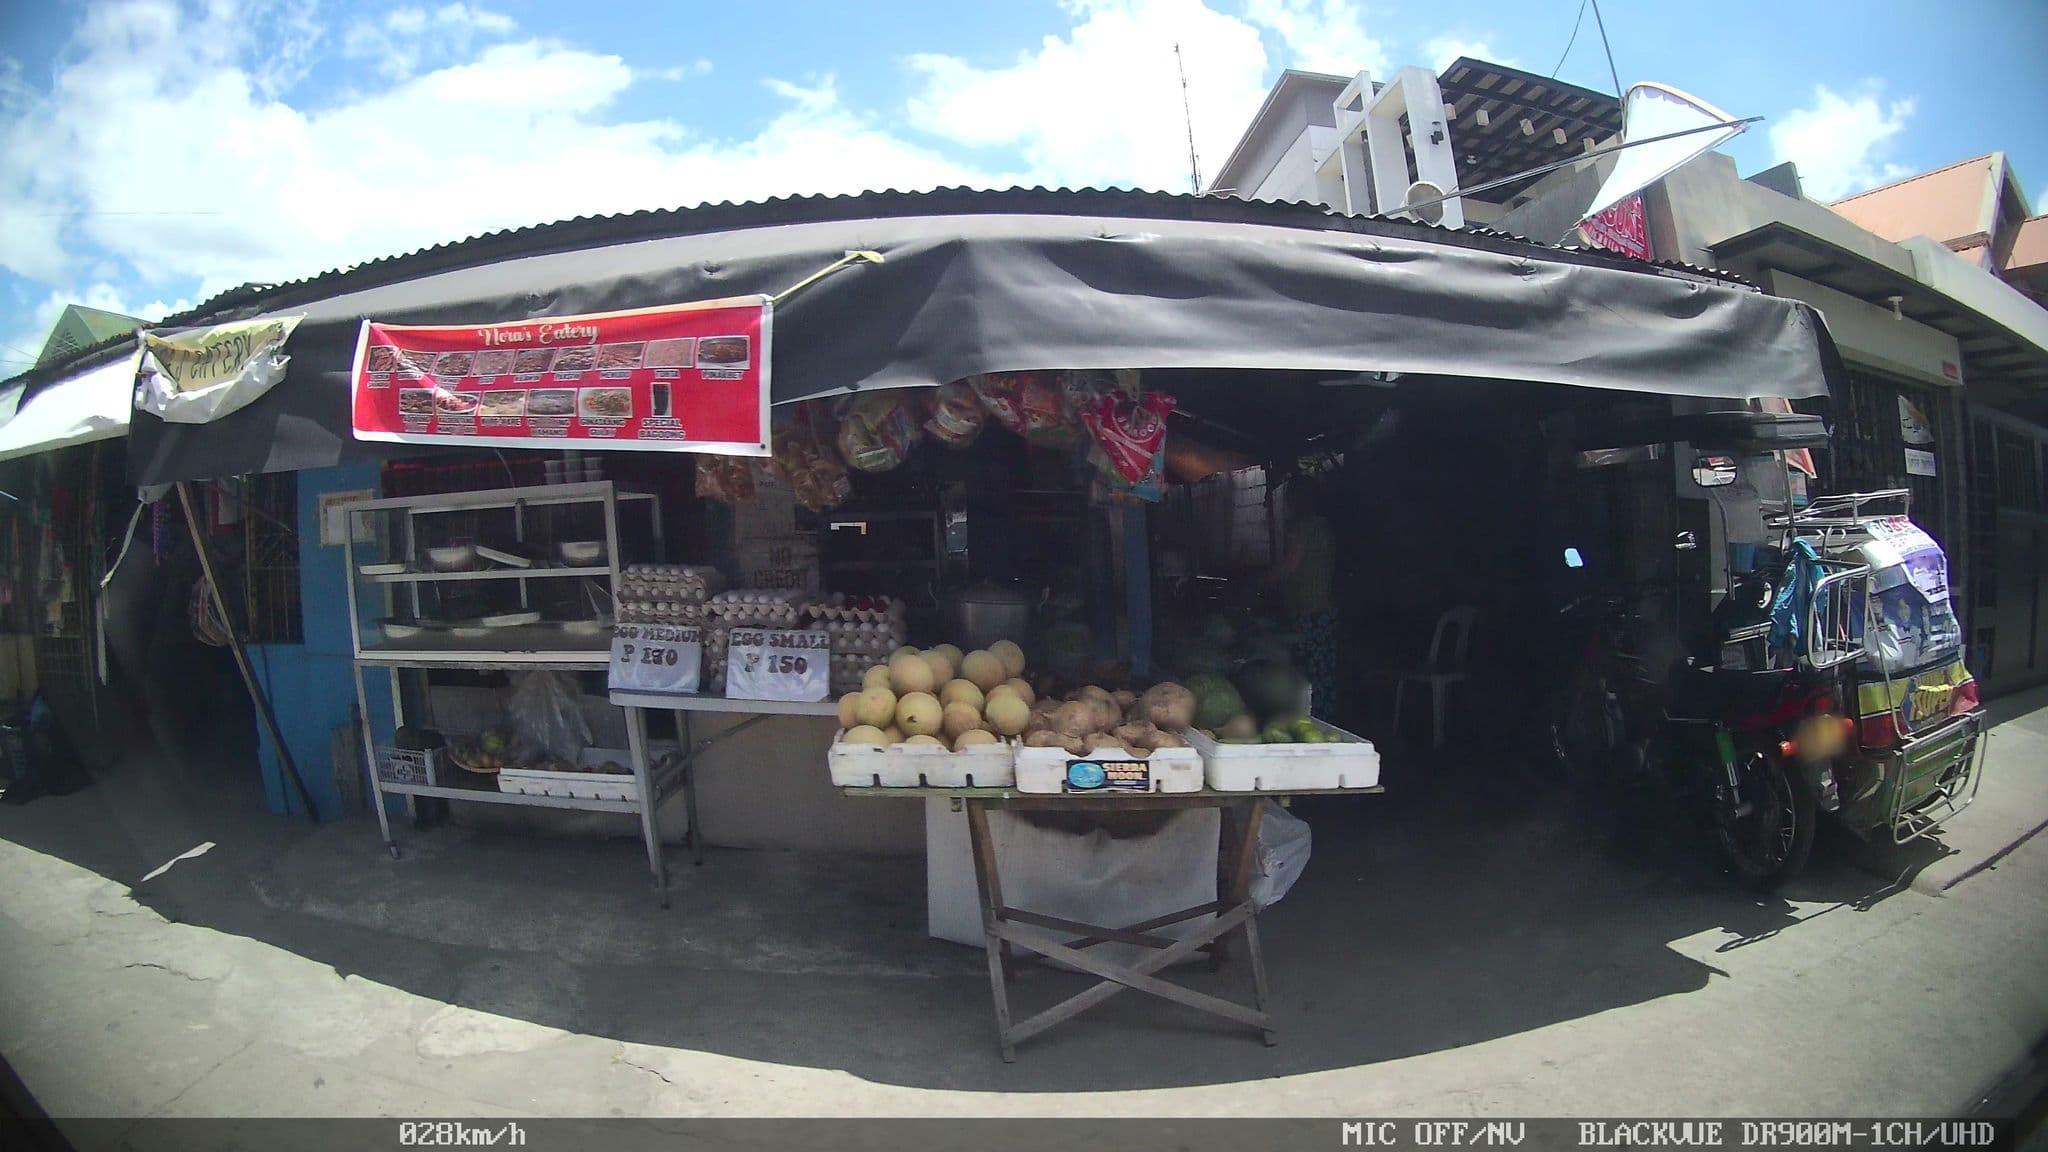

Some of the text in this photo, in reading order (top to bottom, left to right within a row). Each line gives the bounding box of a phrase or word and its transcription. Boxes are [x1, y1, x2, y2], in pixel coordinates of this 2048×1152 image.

[478, 323, 599, 346] Nora's Eatery
[642, 418, 682, 428] SPECIAL
[731, 632, 829, 649] EGG SMALL
[767, 654, 808, 675] 150
[1102, 762, 1148, 772] SIERRA
